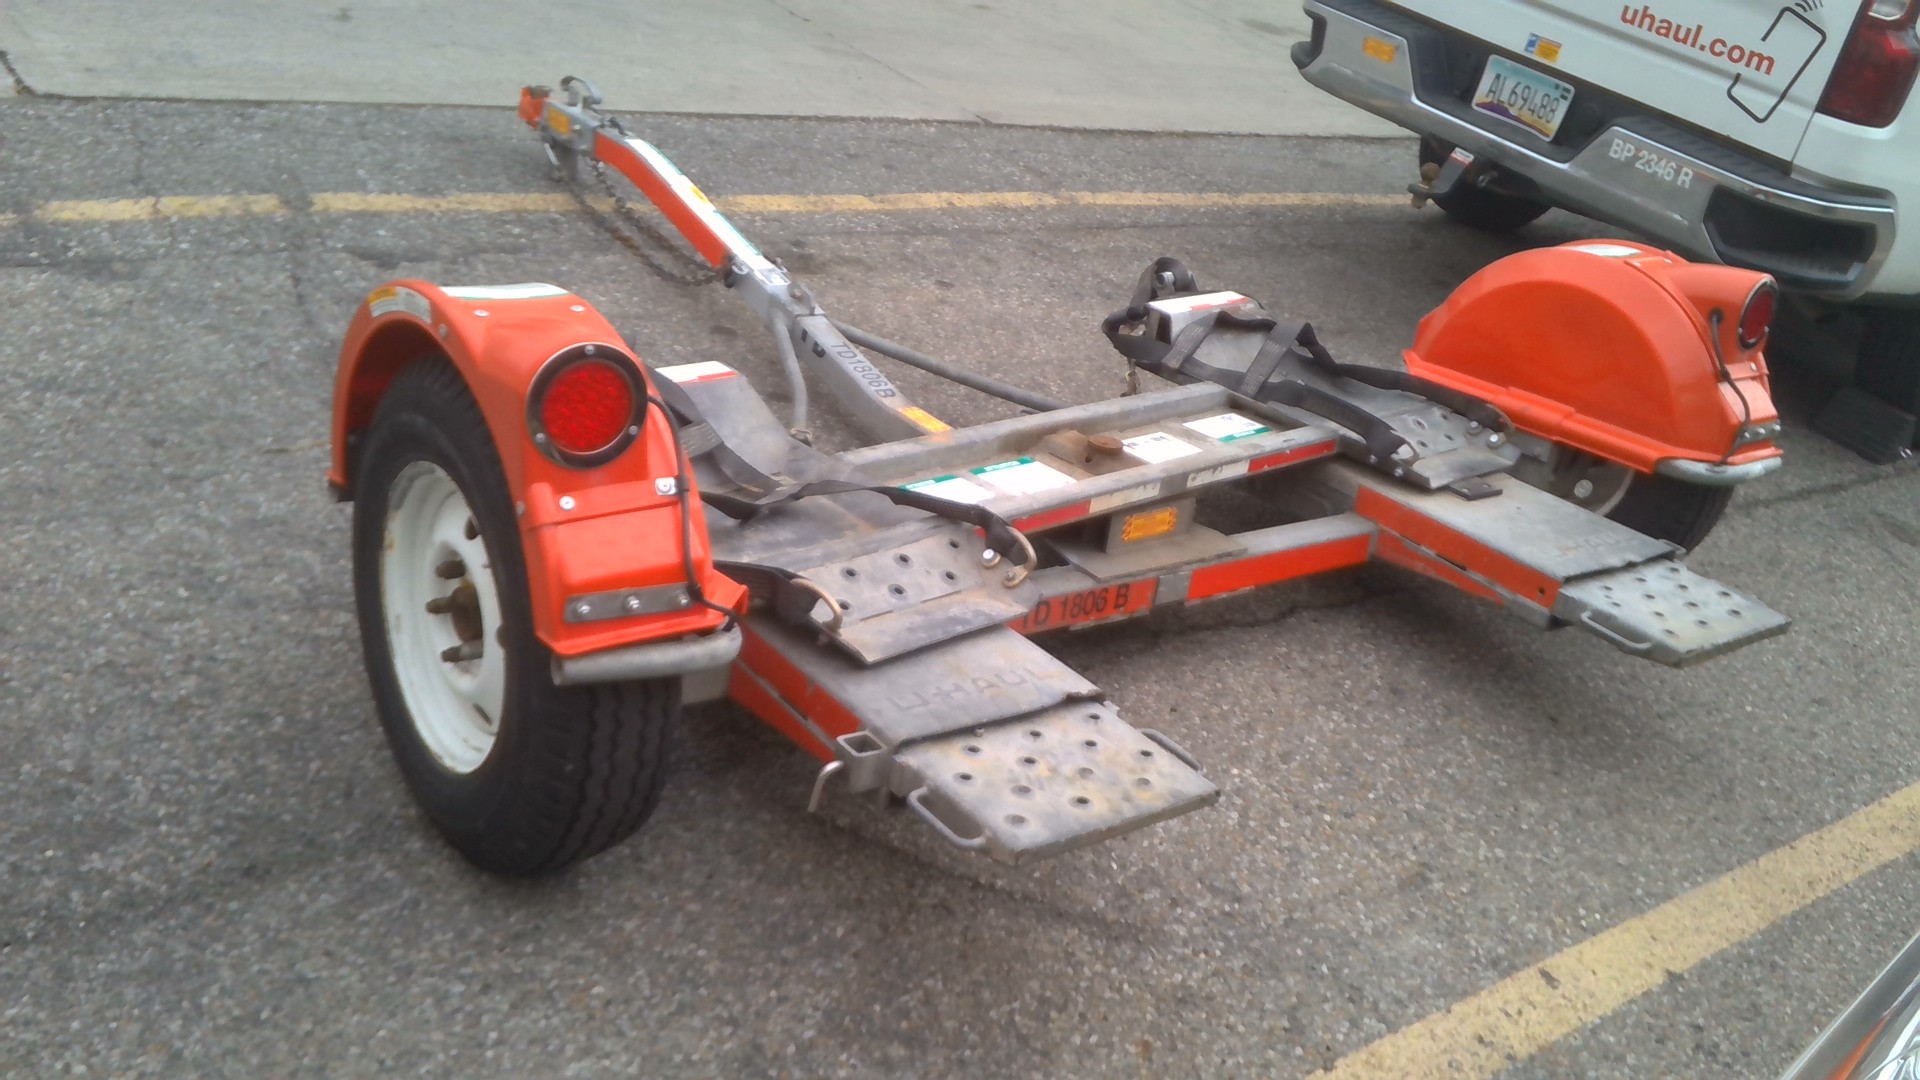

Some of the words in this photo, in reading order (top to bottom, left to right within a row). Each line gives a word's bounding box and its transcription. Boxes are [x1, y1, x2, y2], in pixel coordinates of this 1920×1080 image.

[1620, 5, 1775, 76] uhaul.com
[1608, 138, 1636, 162] BP
[1634, 150, 1677, 181] 2346
[1677, 167, 1694, 189] R
[831, 341, 897, 399] TD1806B
[1059, 587, 1109, 621] 1806
[1113, 583, 1130, 609] B
